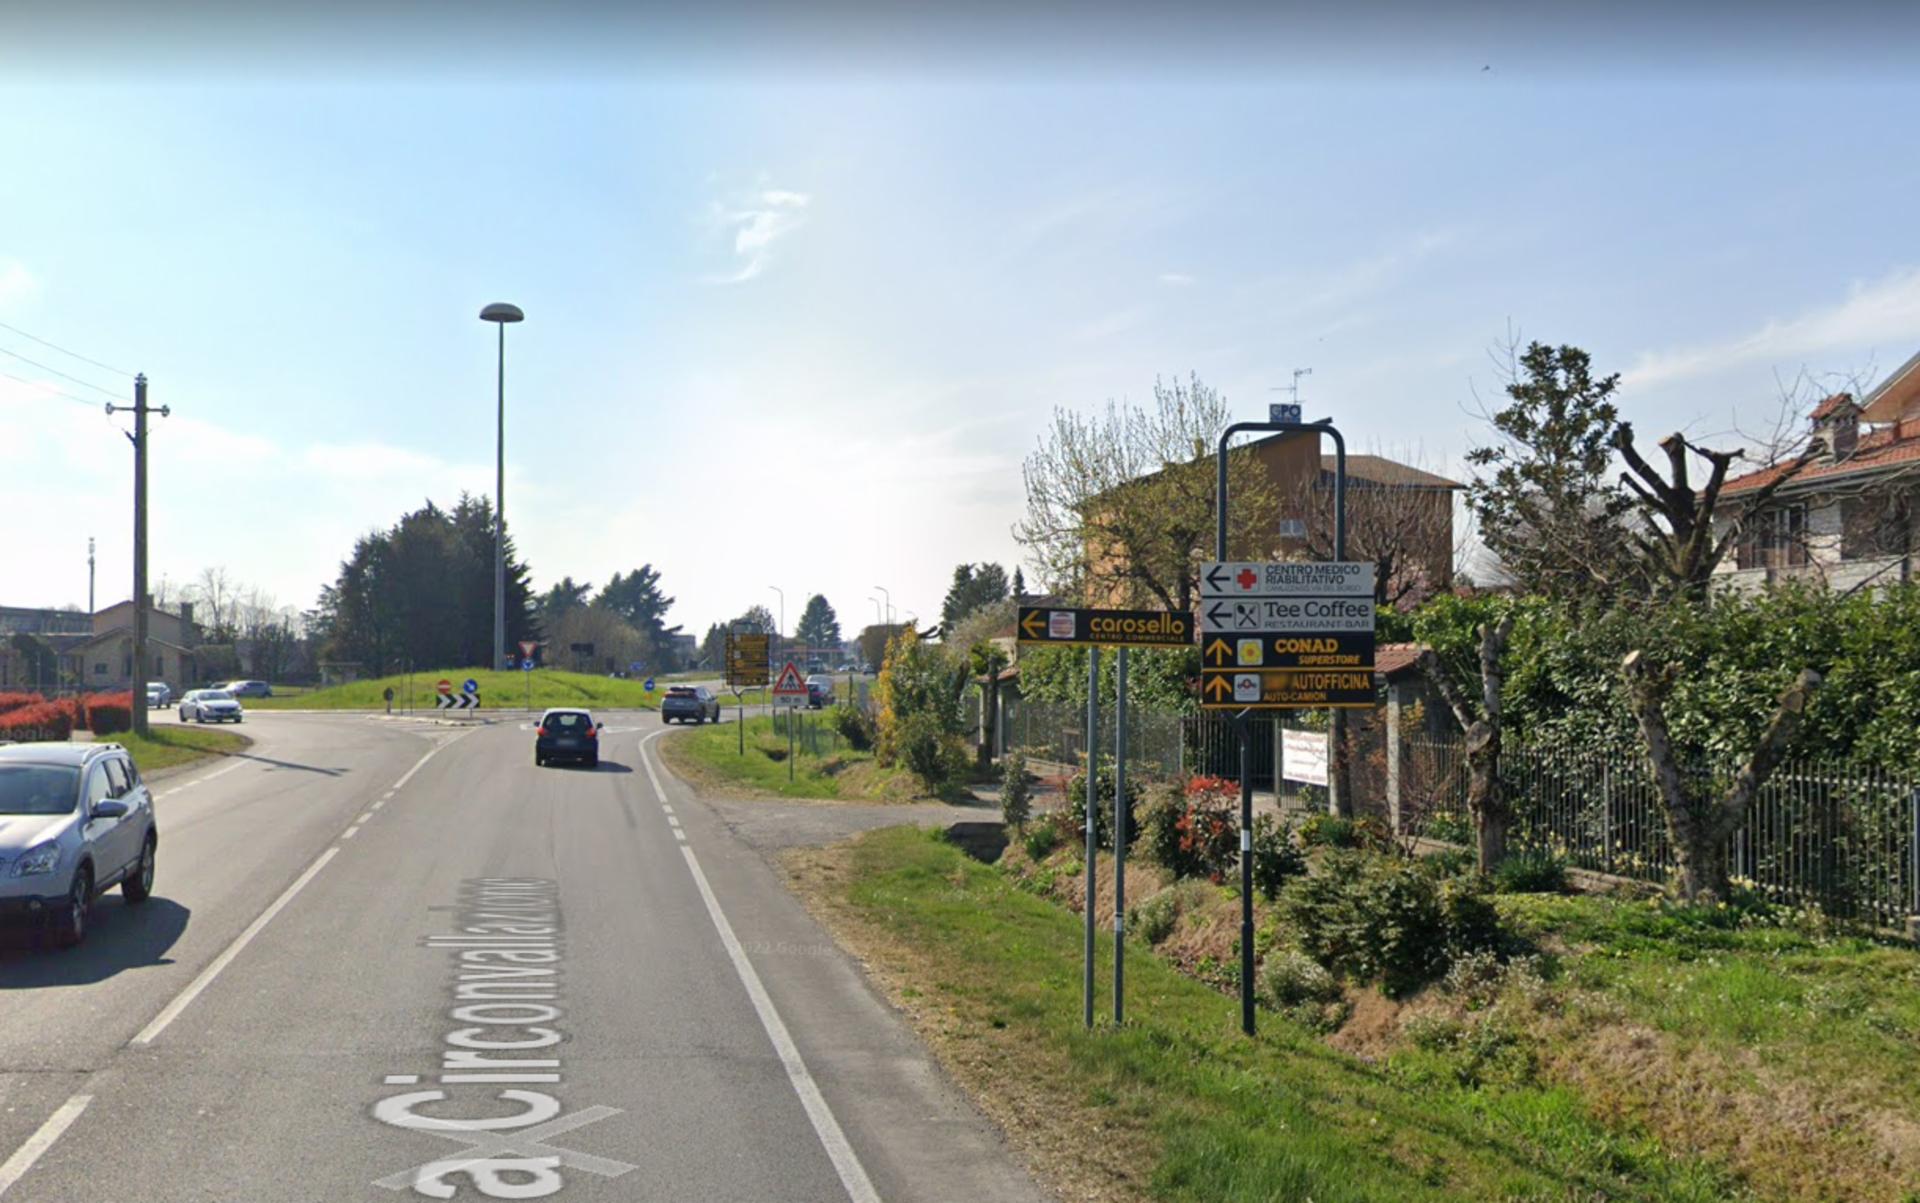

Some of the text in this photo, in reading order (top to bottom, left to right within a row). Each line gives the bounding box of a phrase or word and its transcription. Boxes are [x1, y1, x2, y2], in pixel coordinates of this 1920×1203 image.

[1265, 564, 1361, 575] CENTRO MEDICO
[1265, 574, 1346, 585] RIABILITATIVO
[1264, 600, 1370, 618] Tee Coffee
[1090, 612, 1185, 635] carosello
[1274, 638, 1339, 654] CONAD
[1298, 655, 1361, 665] SUPERSTORE
[1292, 673, 1371, 690] AUTOFFICINA
[1263, 691, 1328, 701] AUTO-CAMION
